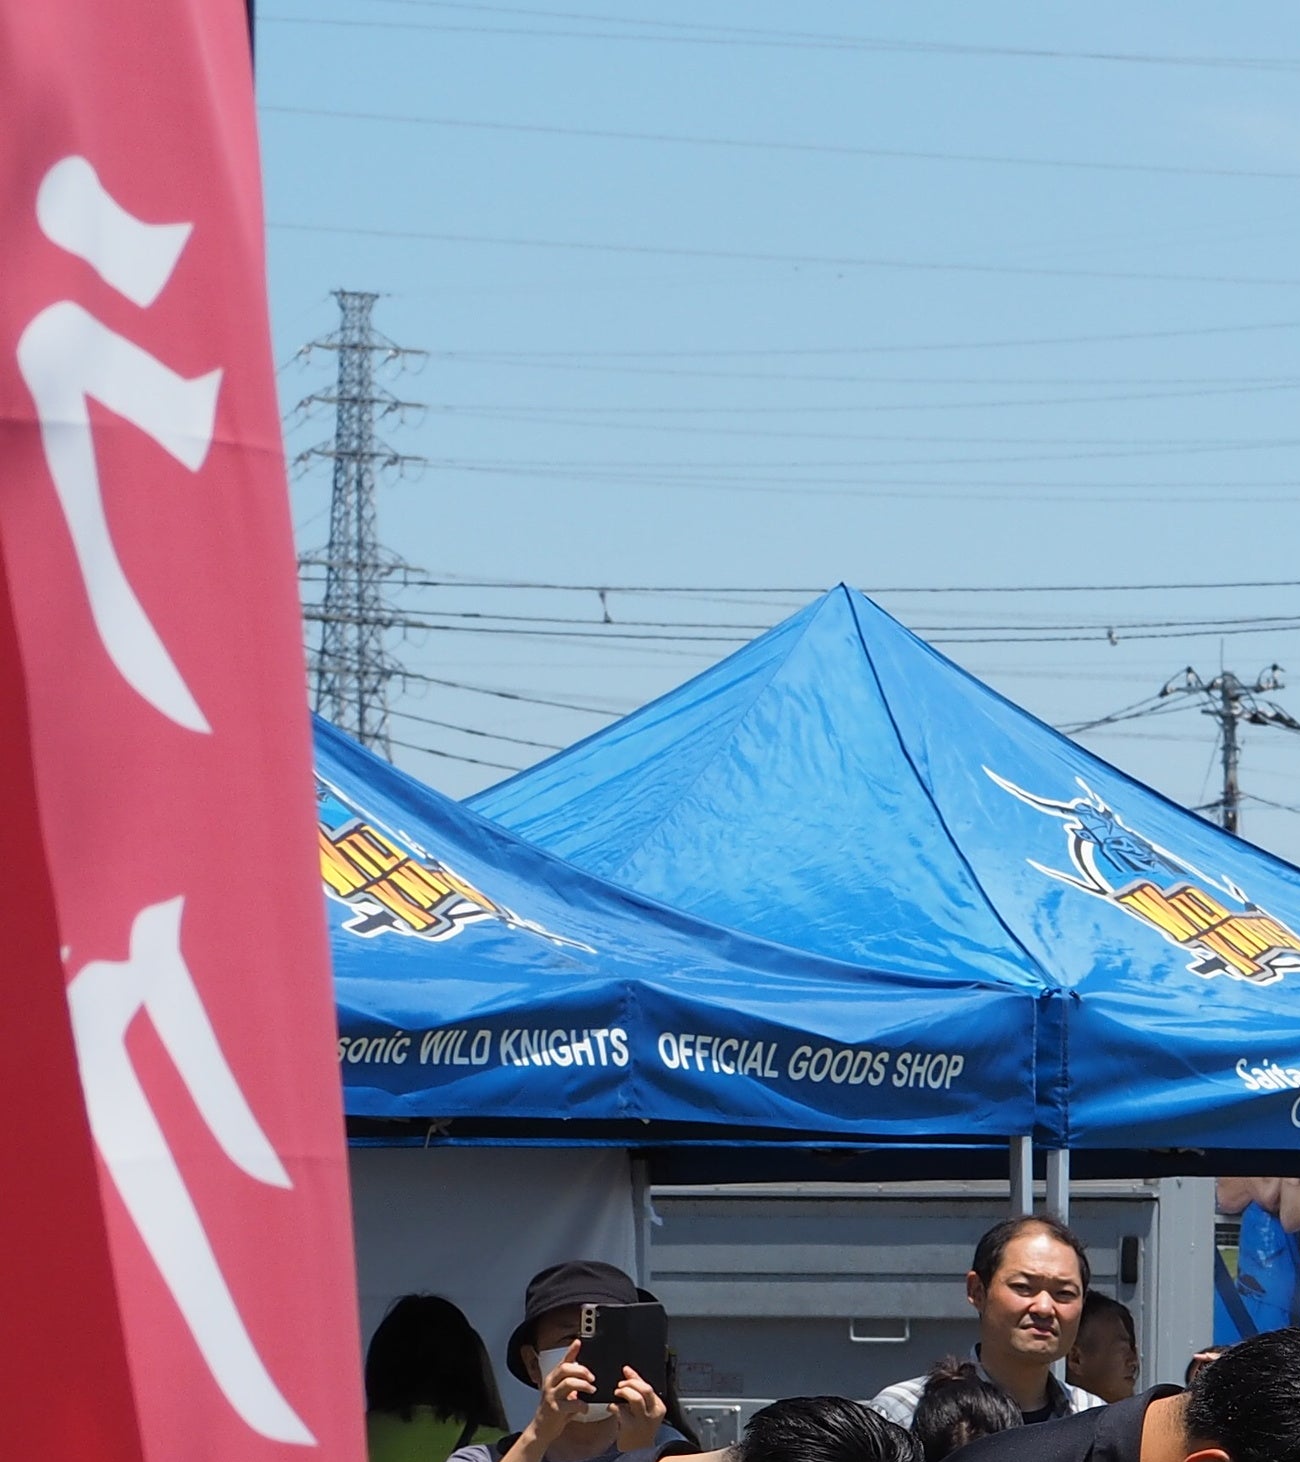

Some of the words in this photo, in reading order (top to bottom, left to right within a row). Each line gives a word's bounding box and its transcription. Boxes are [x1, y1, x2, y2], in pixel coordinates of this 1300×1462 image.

[419, 1029, 492, 1066] WILD
[500, 1027, 630, 1067] KNIGHTS
[657, 1031, 780, 1079] OFFICIAL
[787, 1045, 889, 1087] GOODS
[891, 1052, 965, 1090] SHOP
